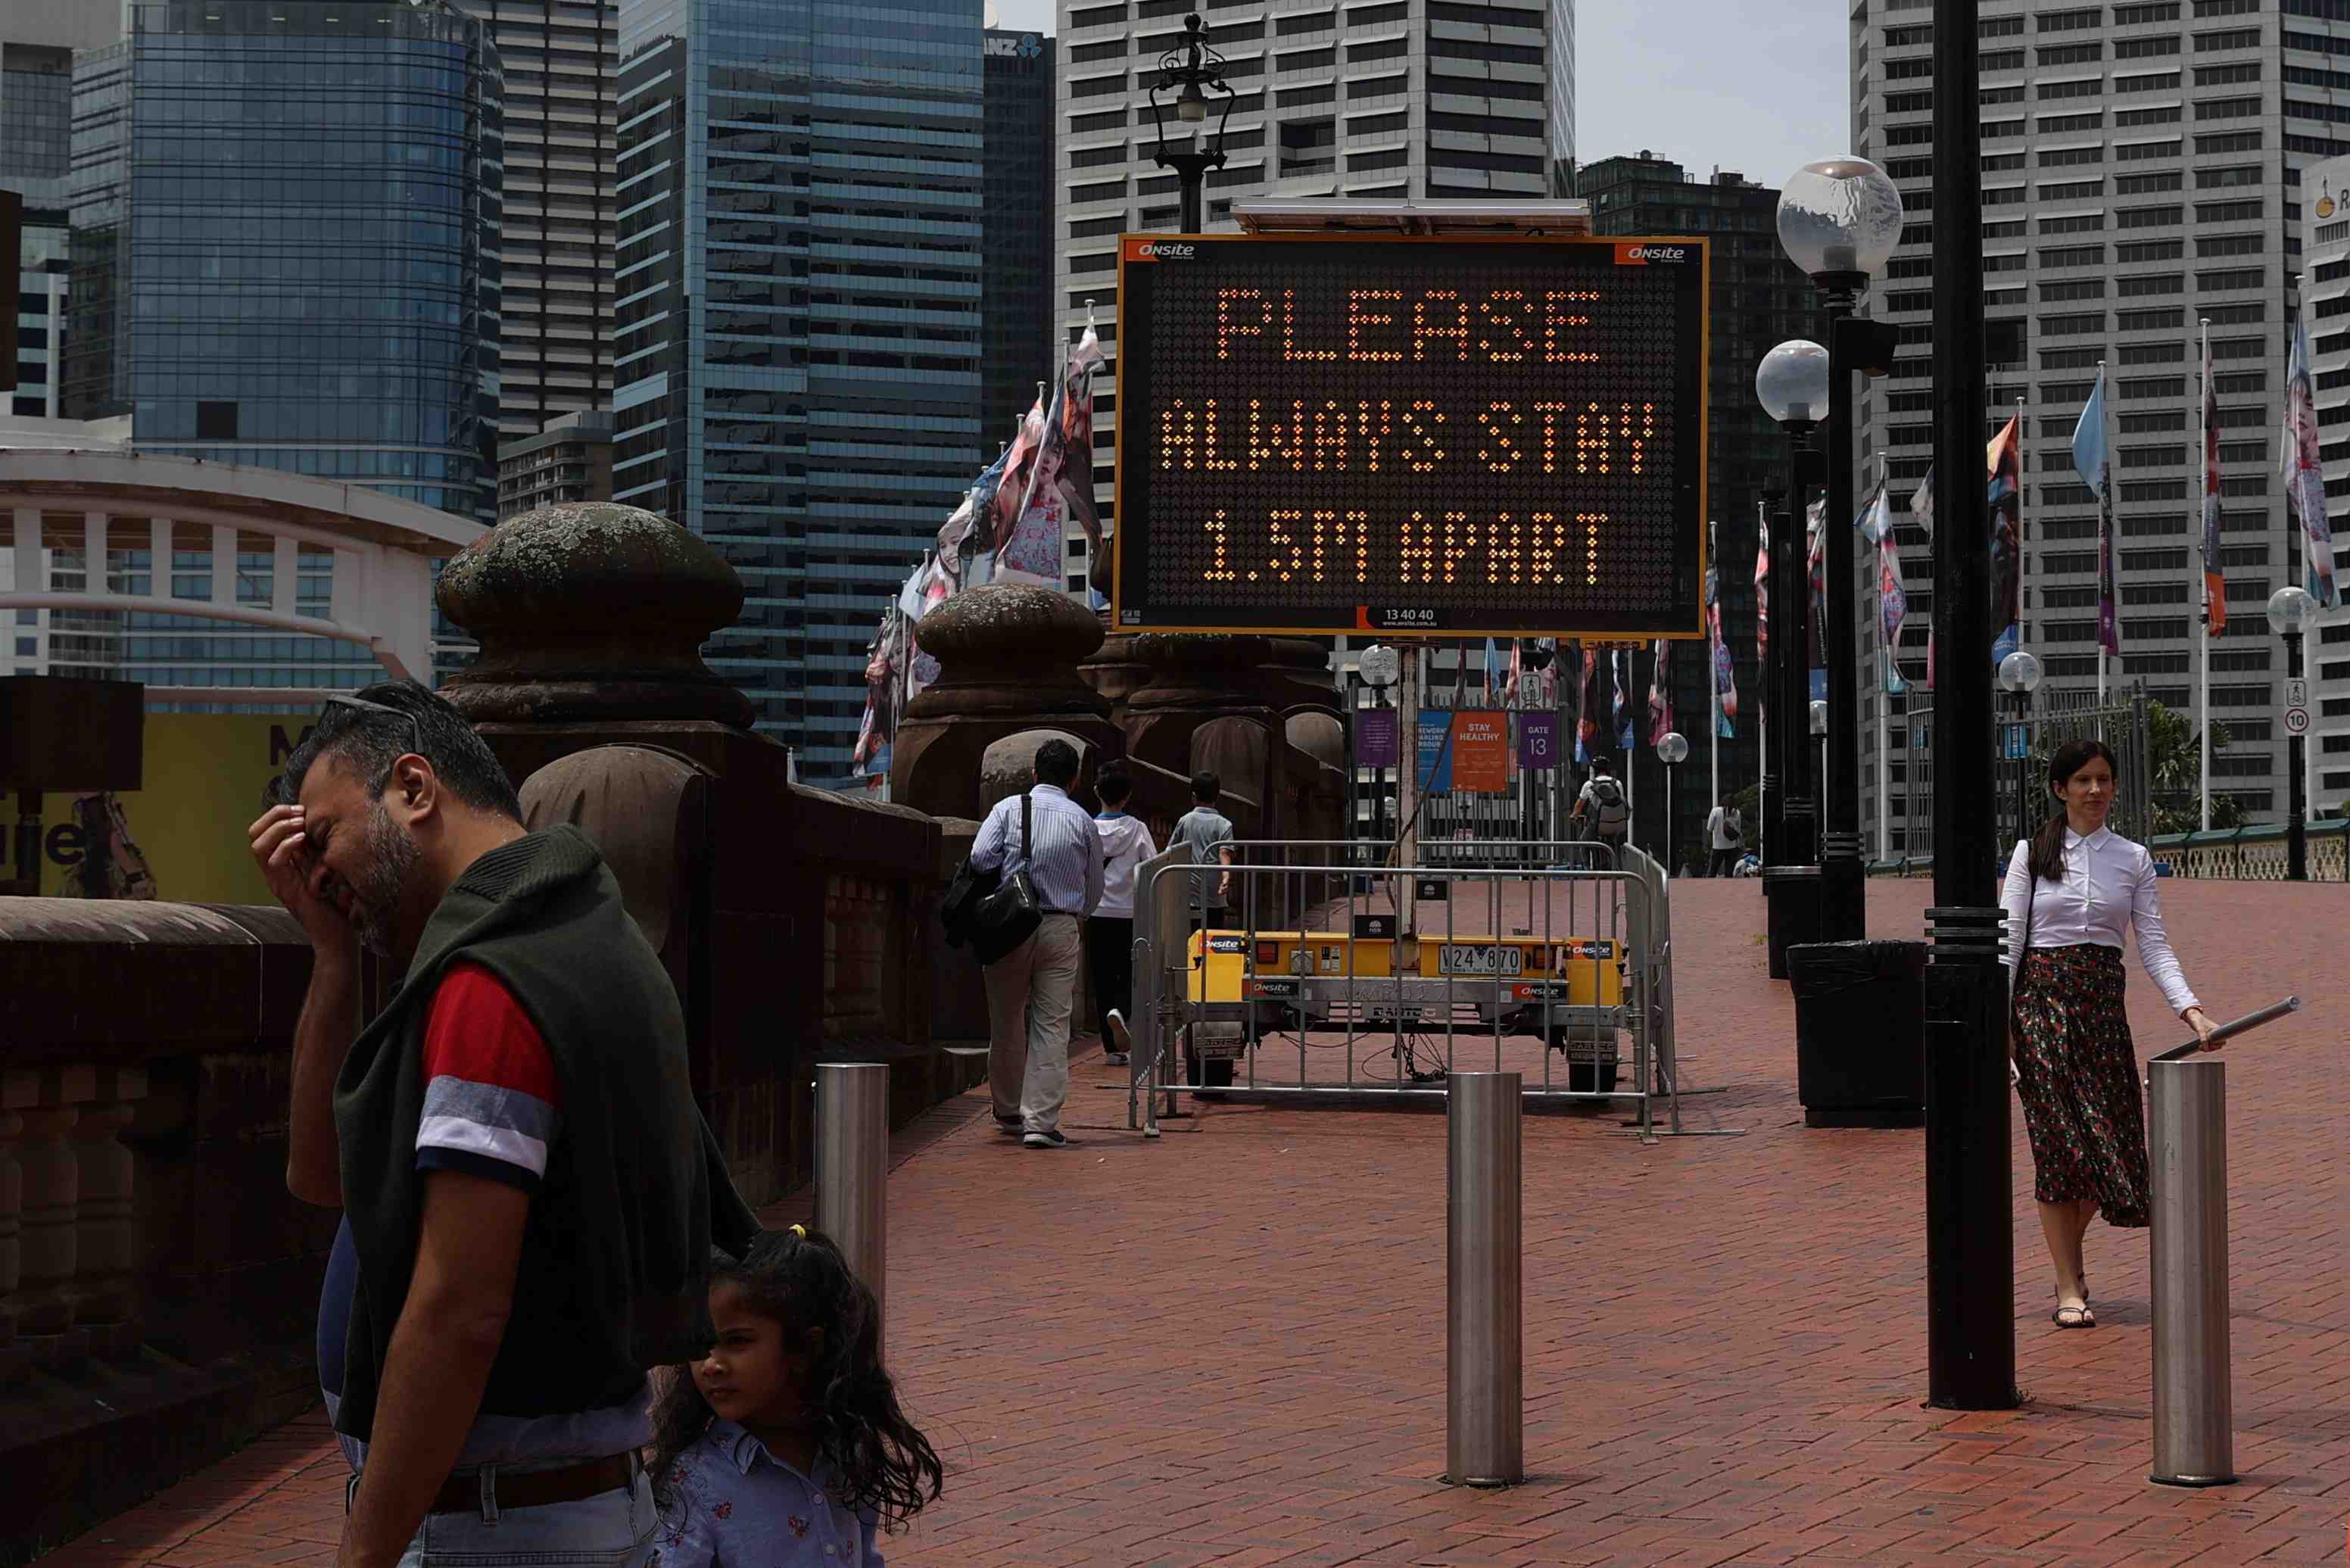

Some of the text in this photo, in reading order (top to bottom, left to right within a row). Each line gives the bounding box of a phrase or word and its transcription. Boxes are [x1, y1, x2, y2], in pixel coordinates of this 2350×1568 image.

[1217, 288, 1600, 363] PLEASE
[1161, 398, 1653, 474] ALWAYS STAY
[1203, 509, 1609, 584] 1.5M APART
[1386, 609, 1434, 619] 13 40 40
[1467, 723, 1491, 732] STAY
[2290, 715, 2304, 727] 10
[1459, 733, 1500, 741] HEALTHY
[1530, 739, 1547, 756] 13
[1488, 950, 1519, 968] 870
